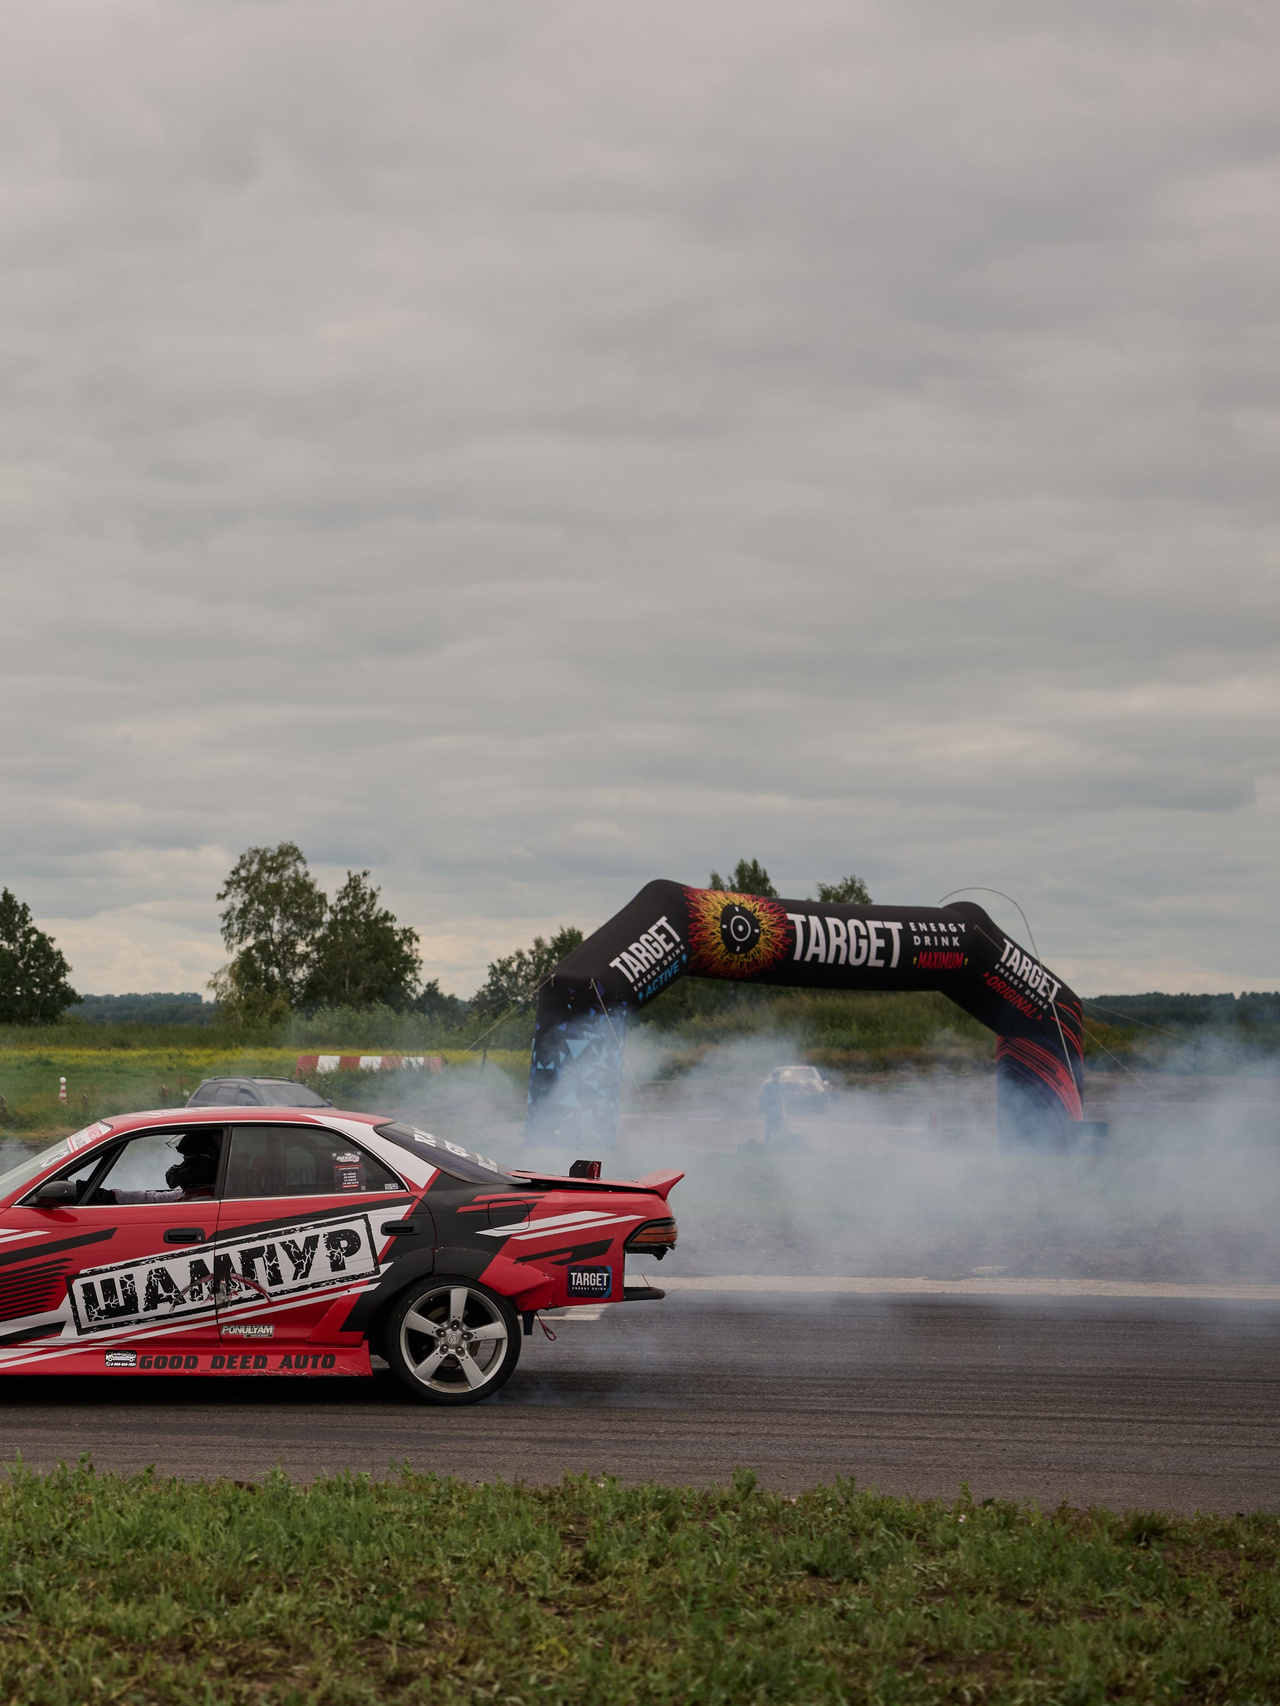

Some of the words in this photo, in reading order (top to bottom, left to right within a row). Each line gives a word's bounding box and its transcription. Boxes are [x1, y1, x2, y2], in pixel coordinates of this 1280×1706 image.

[609, 915, 681, 983] TARGET
[786, 913, 903, 968] TARGET
[909, 922, 966, 933] ENERGY
[913, 935, 960, 947] DRINK
[633, 966, 661, 992] ENERGY
[662, 943, 686, 966] DRINK
[645, 960, 680, 998] ACTIVE
[917, 951, 964, 969] MAXIMUM
[1000, 938, 1062, 1003] TARGET
[986, 976, 1038, 1019] ORIGINAL
[994, 963, 1023, 989] ENERGY
[1024, 988, 1049, 1011] DRINK
[80, 1228, 362, 1322] ШАМПУР
[570, 1272, 609, 1286] TARGET
[221, 1325, 274, 1335] PONULYAM
